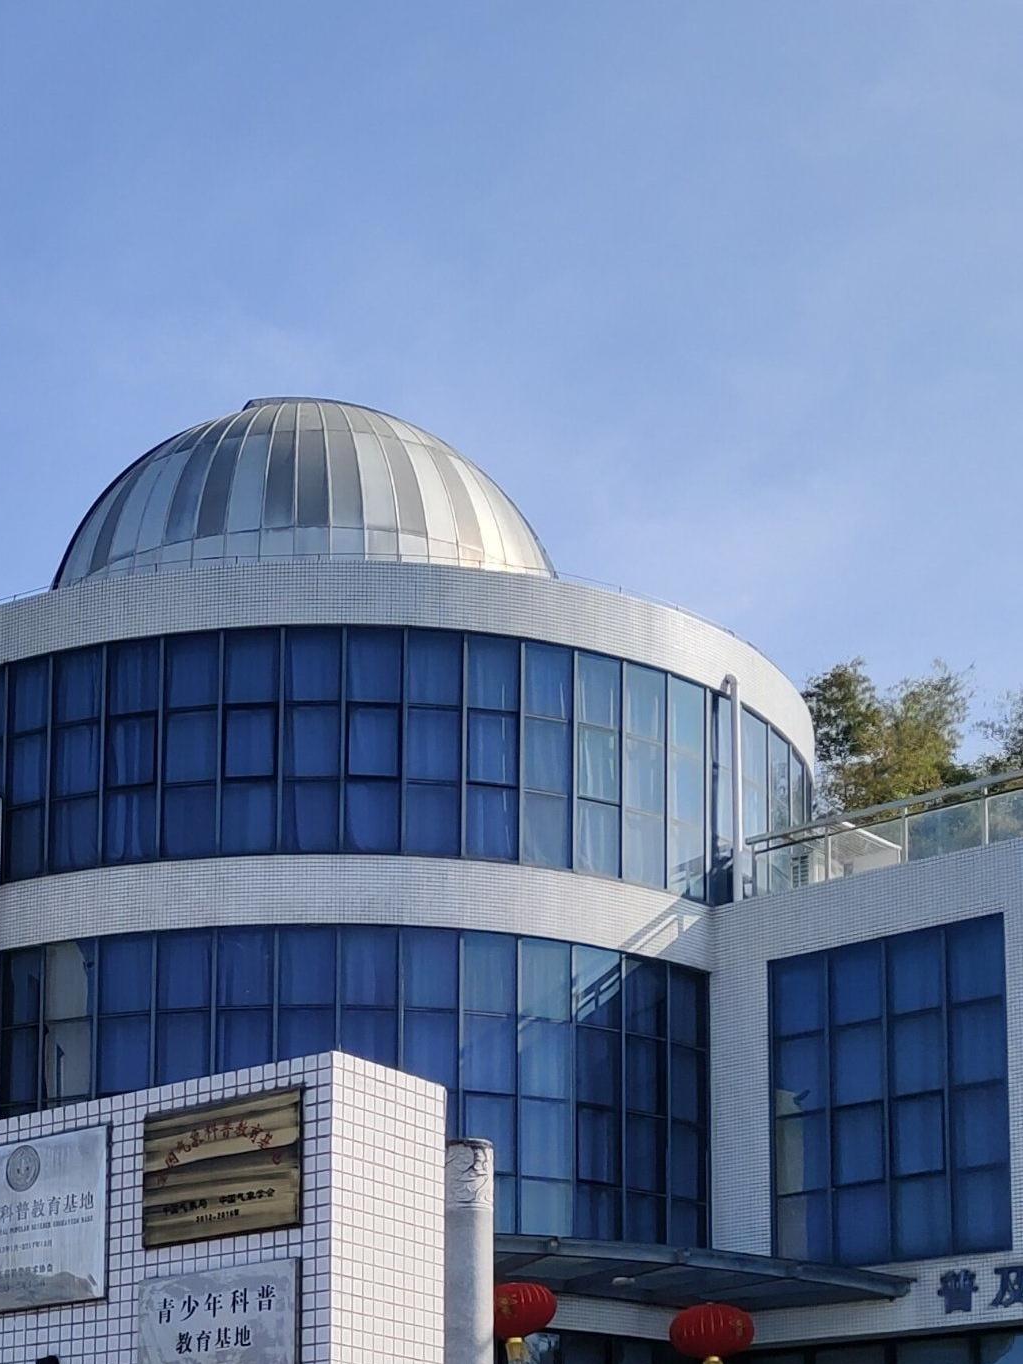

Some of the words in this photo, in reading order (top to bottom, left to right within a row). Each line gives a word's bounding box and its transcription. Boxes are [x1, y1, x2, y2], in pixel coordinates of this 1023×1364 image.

[219, 1187, 276, 1205] 中国气象学会
[158, 1284, 276, 1325] 青少年科普
[176, 1325, 252, 1354] 教育基地
